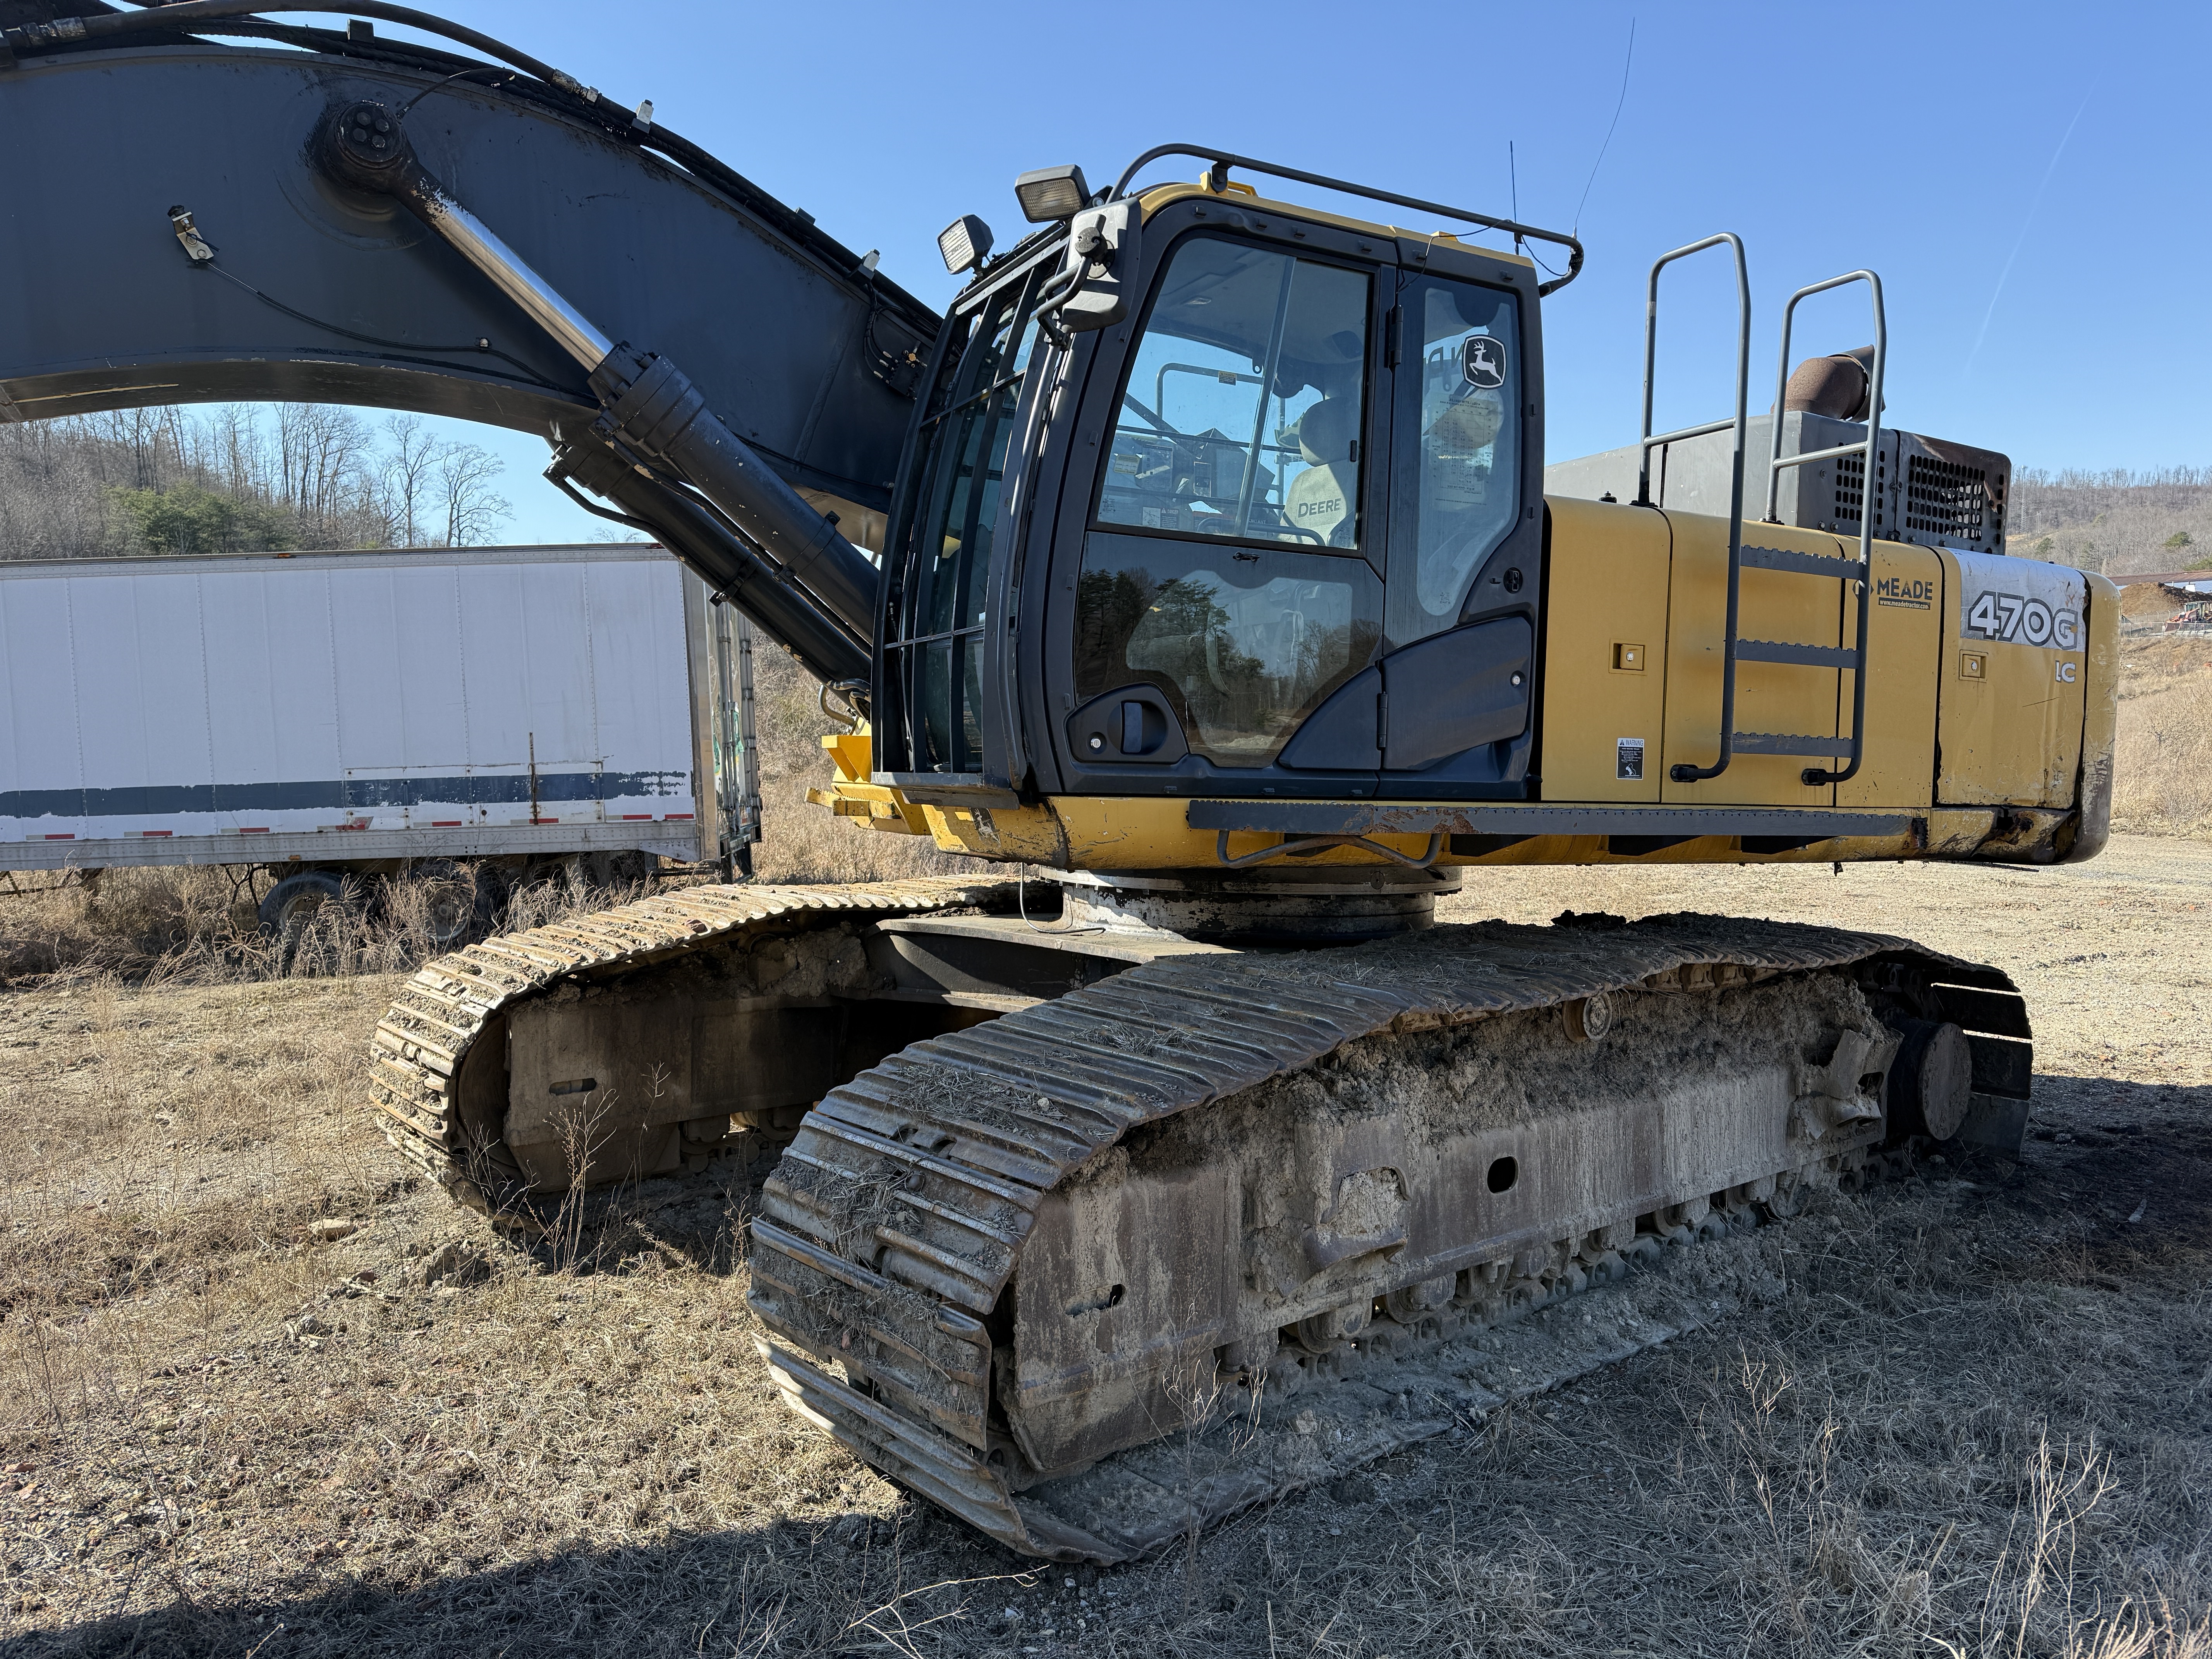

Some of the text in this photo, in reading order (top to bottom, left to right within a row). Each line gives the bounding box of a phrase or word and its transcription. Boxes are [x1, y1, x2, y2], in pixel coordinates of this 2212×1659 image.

[1298, 498, 1341, 518] DEERE
[1877, 576, 1933, 600] MEADE
[1880, 600, 1929, 609] www.meadetractor.com
[1968, 590, 2078, 651] 470G
